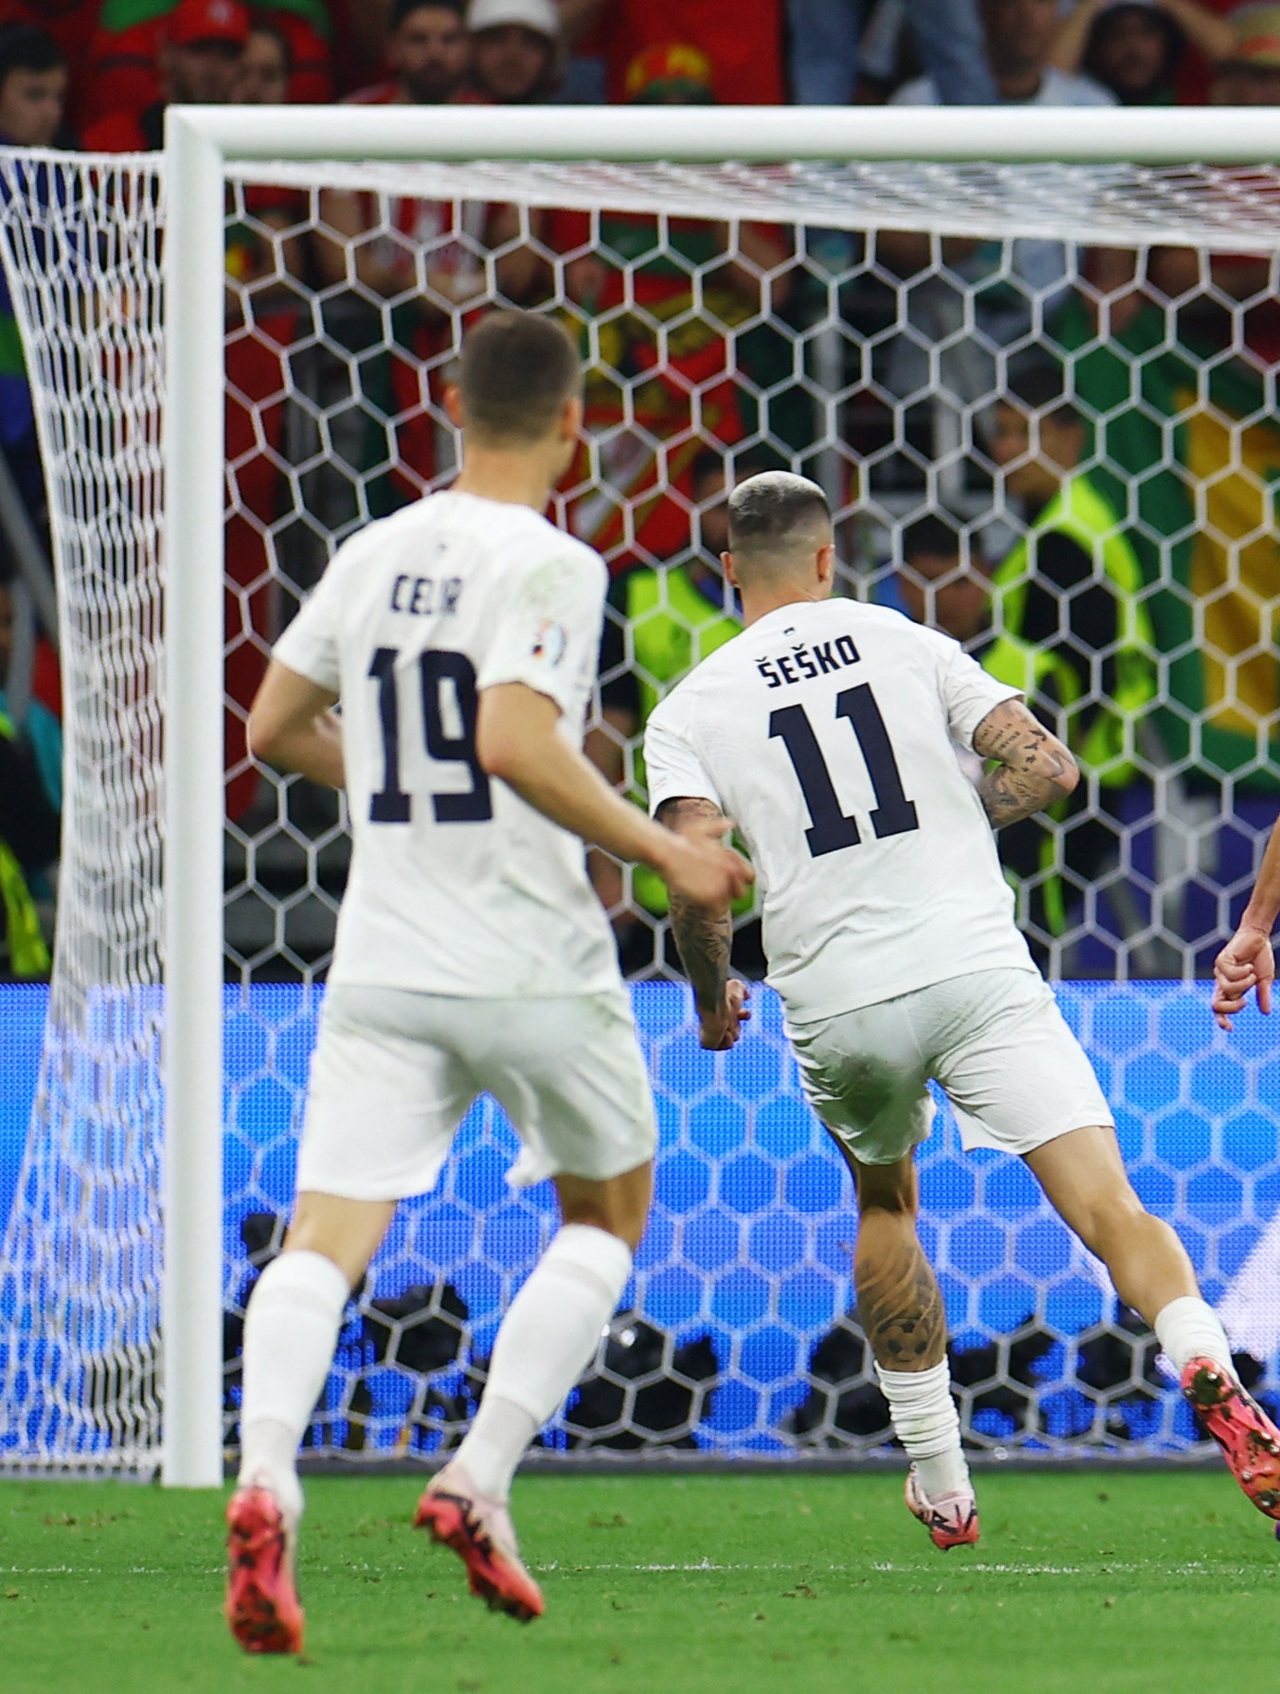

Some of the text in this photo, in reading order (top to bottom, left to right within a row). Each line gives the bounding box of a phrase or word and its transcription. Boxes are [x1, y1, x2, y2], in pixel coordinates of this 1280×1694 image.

[389, 574, 463, 616] CER
[754, 634, 861, 689] ŠEŠKO
[367, 647, 493, 823] 19
[768, 682, 920, 858] 11
